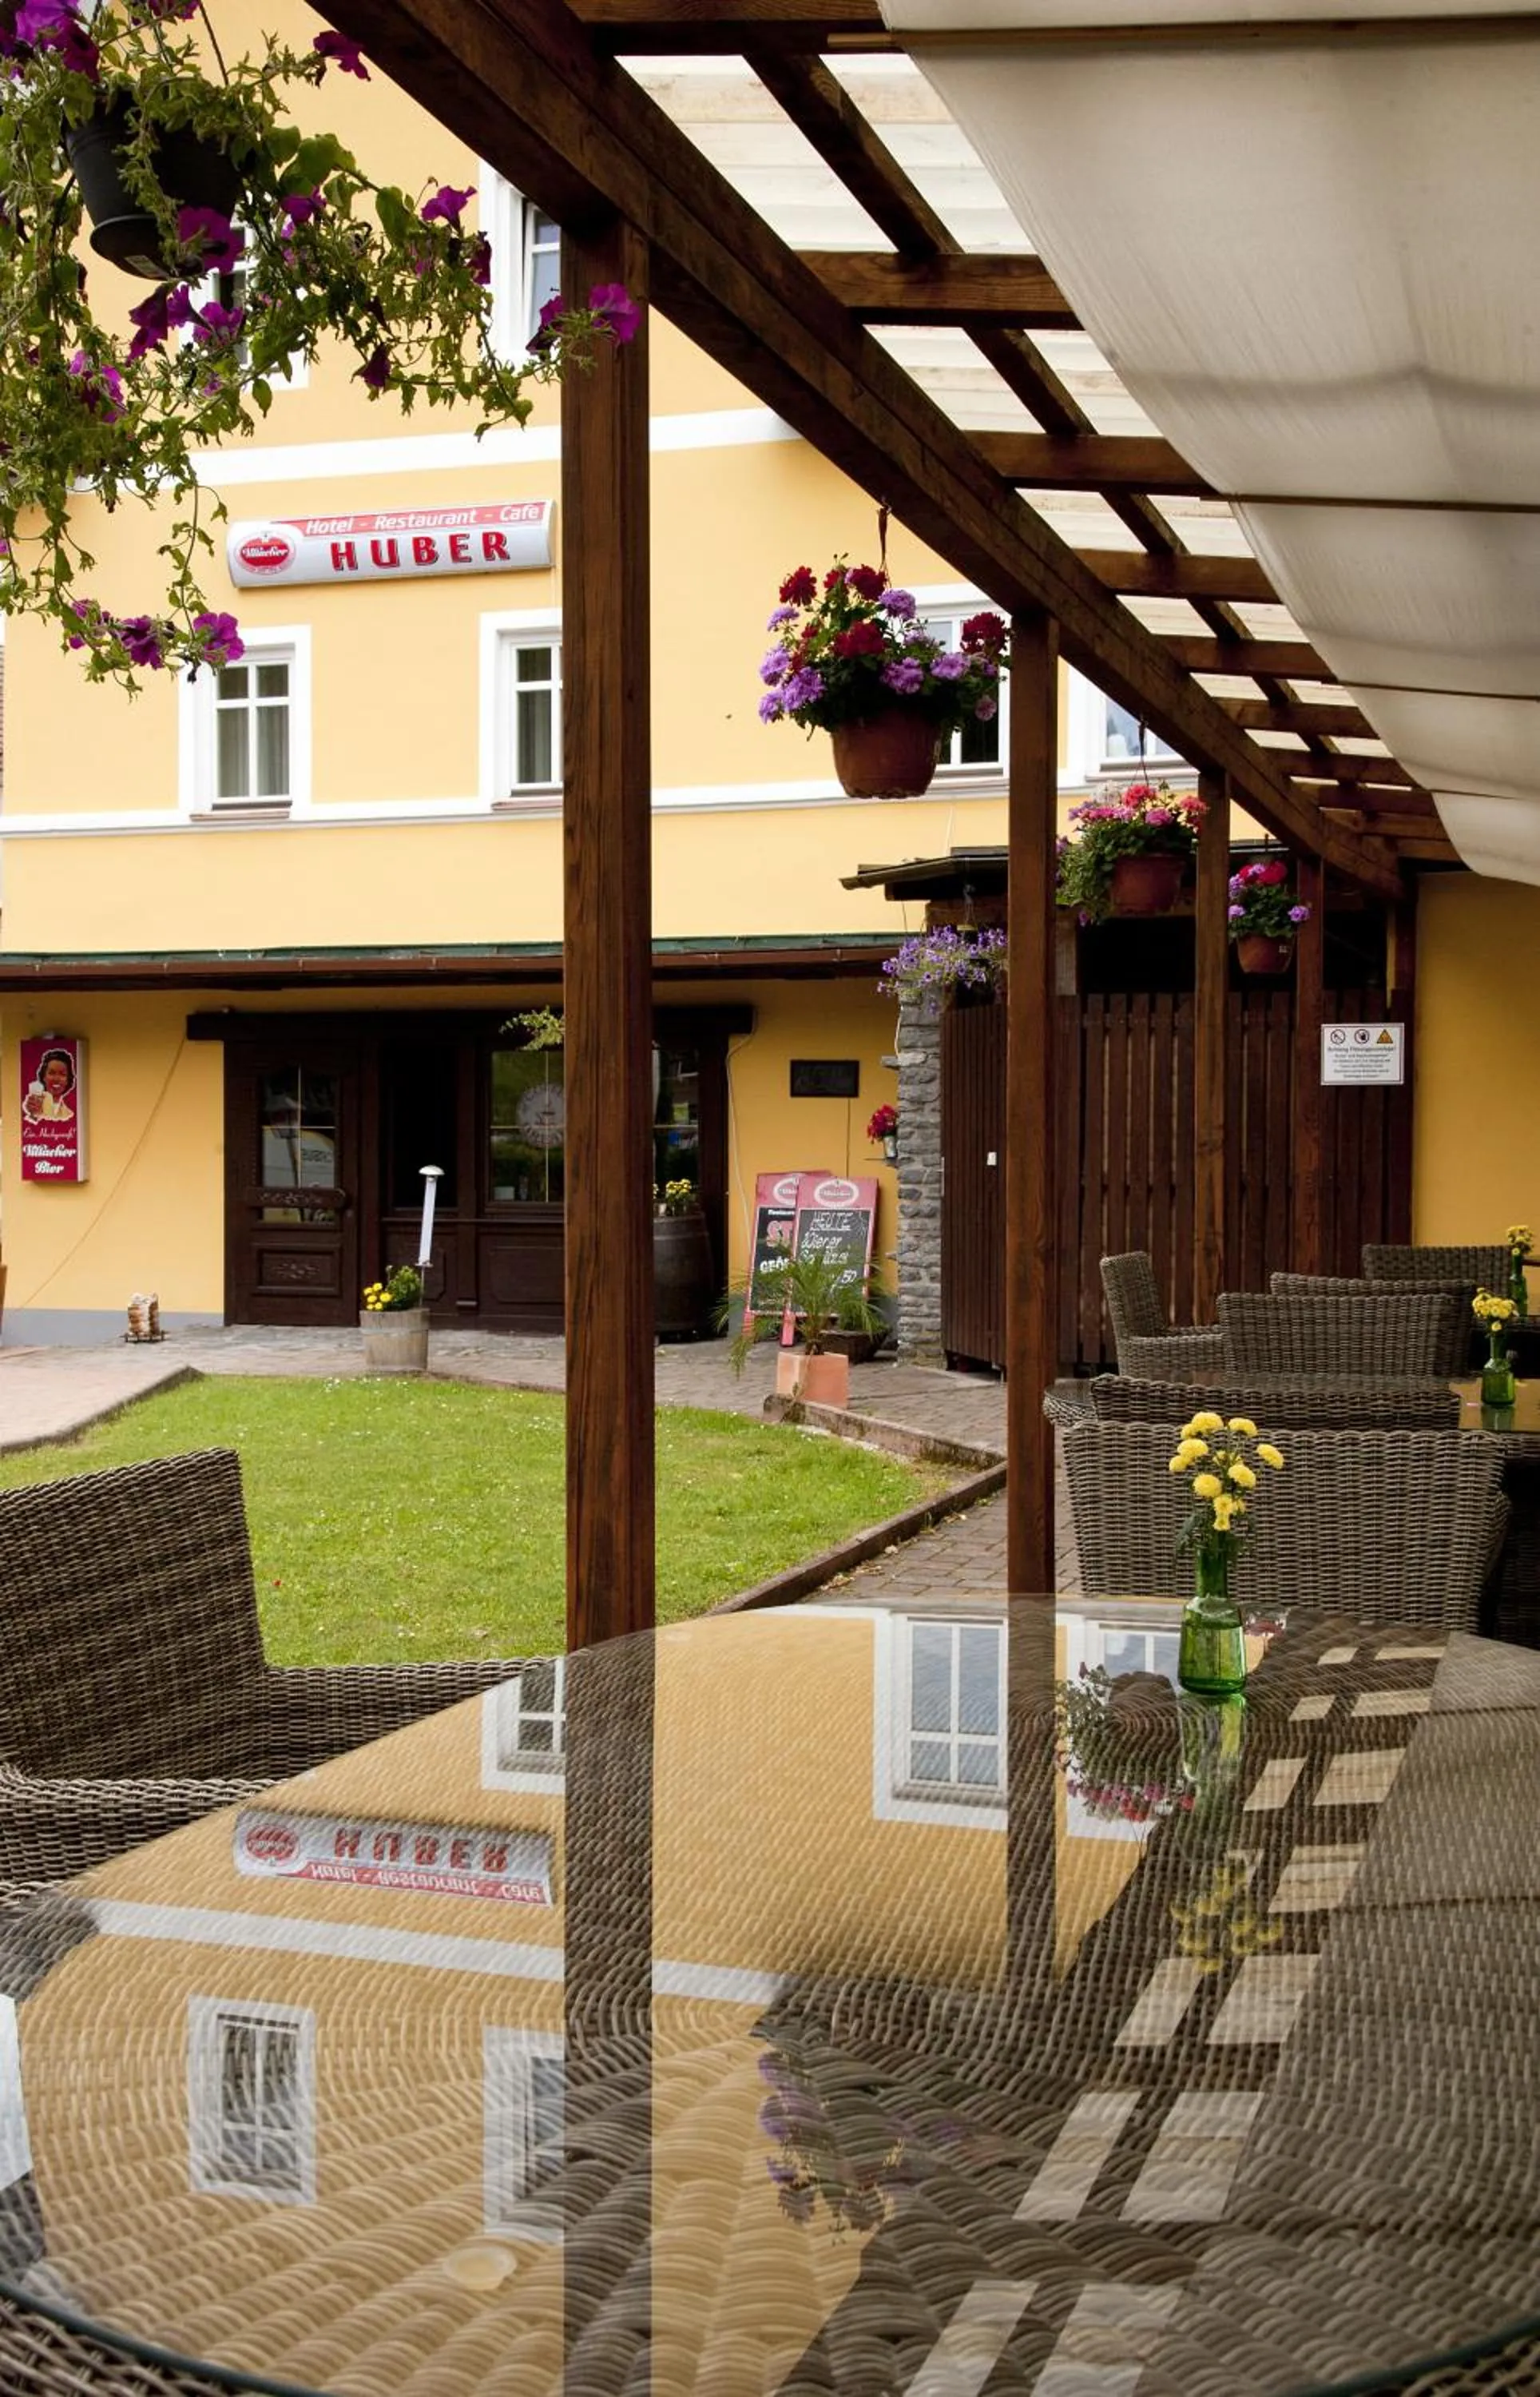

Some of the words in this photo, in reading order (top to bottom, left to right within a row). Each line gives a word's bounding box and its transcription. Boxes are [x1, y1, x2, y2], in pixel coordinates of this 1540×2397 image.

[306, 518, 352, 535] Hotel
[375, 509, 477, 531] Restaurant
[499, 504, 538, 522] Cafe
[330, 531, 510, 571] HUBER
[22, 1144, 77, 1158] Villacher
[34, 1161, 64, 1174] Bier
